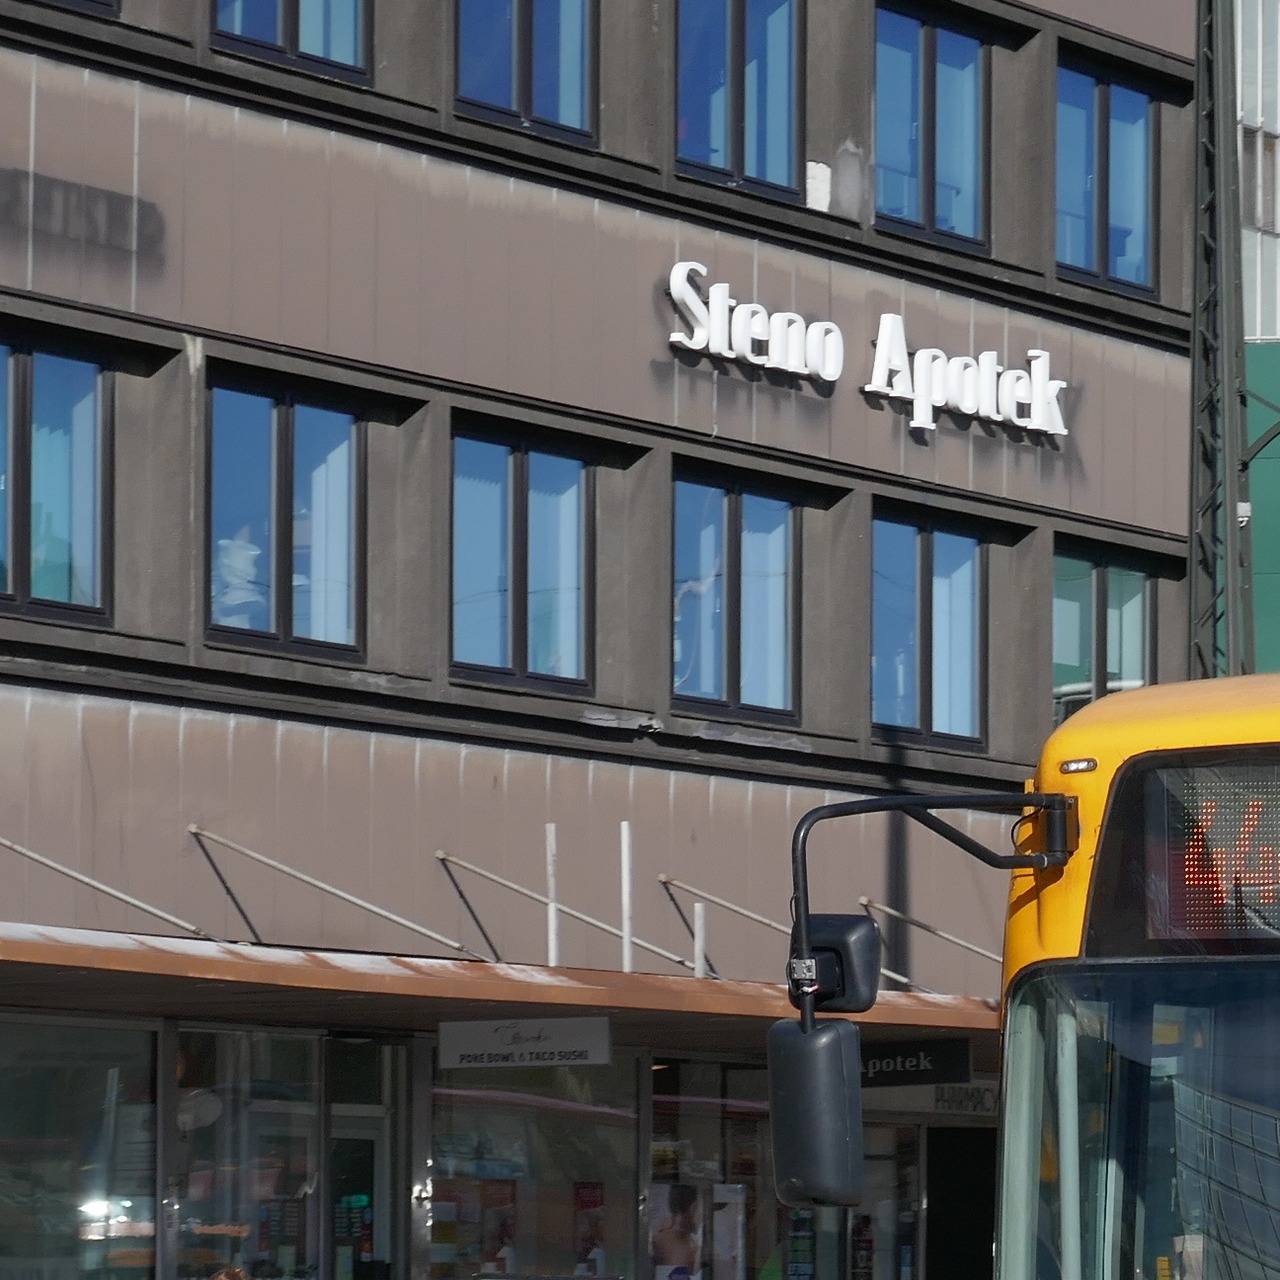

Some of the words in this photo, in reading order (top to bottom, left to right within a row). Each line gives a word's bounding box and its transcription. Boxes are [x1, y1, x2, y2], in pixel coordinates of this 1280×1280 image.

[669, 262, 844, 381] Steno
[865, 313, 1068, 435] Apotek
[860, 1051, 934, 1077] potek
